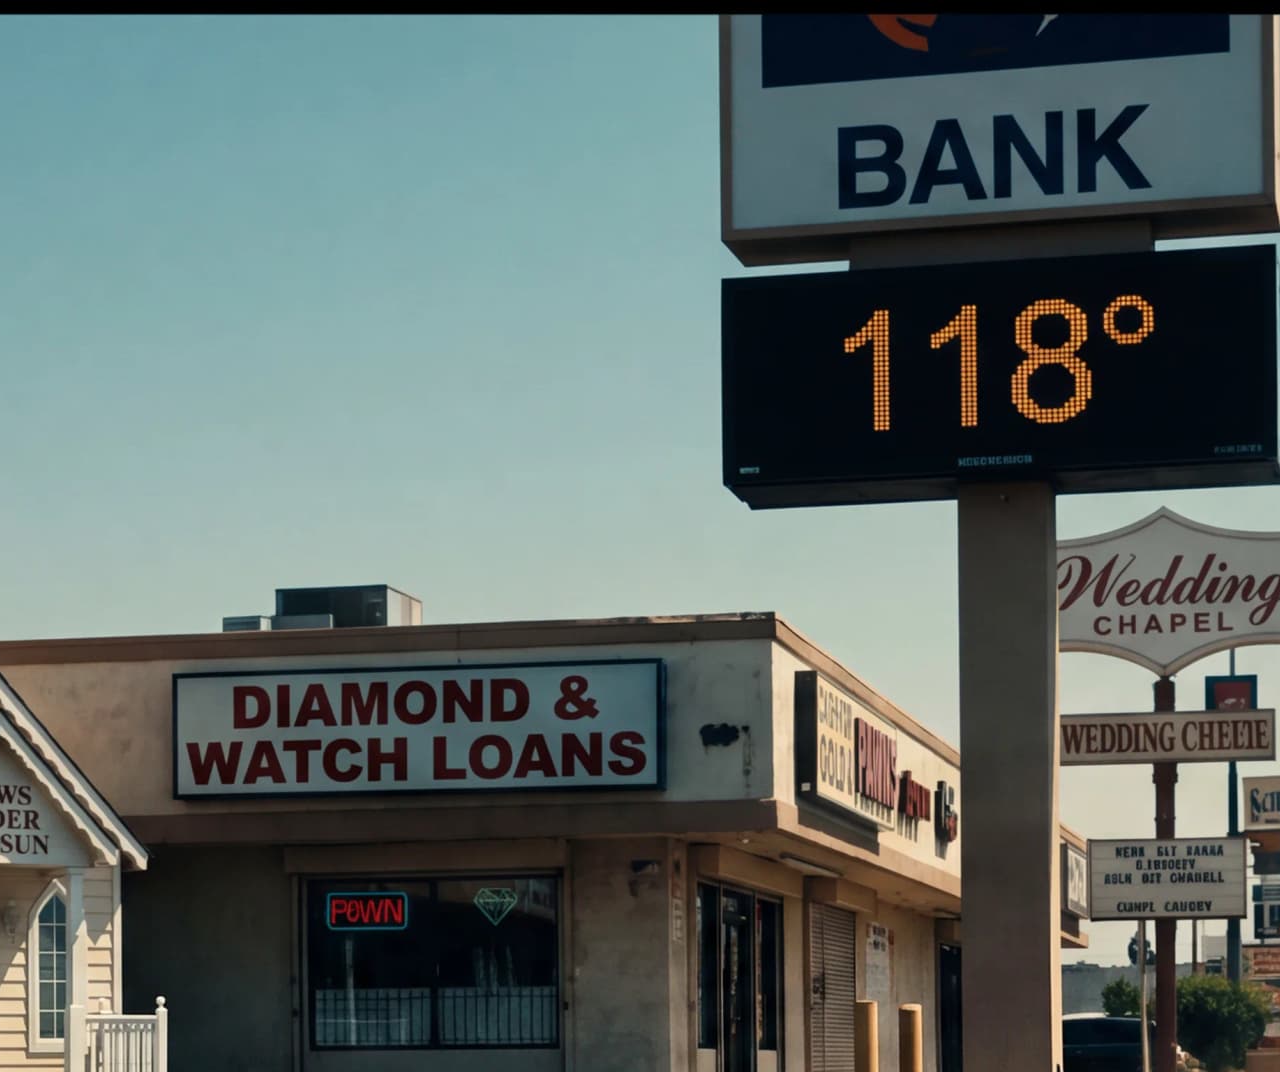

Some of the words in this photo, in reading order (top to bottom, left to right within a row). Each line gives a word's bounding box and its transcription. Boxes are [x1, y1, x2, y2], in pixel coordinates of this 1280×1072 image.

[837, 103, 1153, 210] BANK
[843, 294, 1155, 432] 118°
[1093, 611, 1234, 636] CHAPEL
[233, 677, 531, 730] DIAMOND
[554, 675, 601, 721] &
[186, 736, 409, 786] WATCH
[432, 730, 648, 781] LOANS
[1060, 721, 1176, 755] WEDDING
[0, 834, 50, 855] SUN
